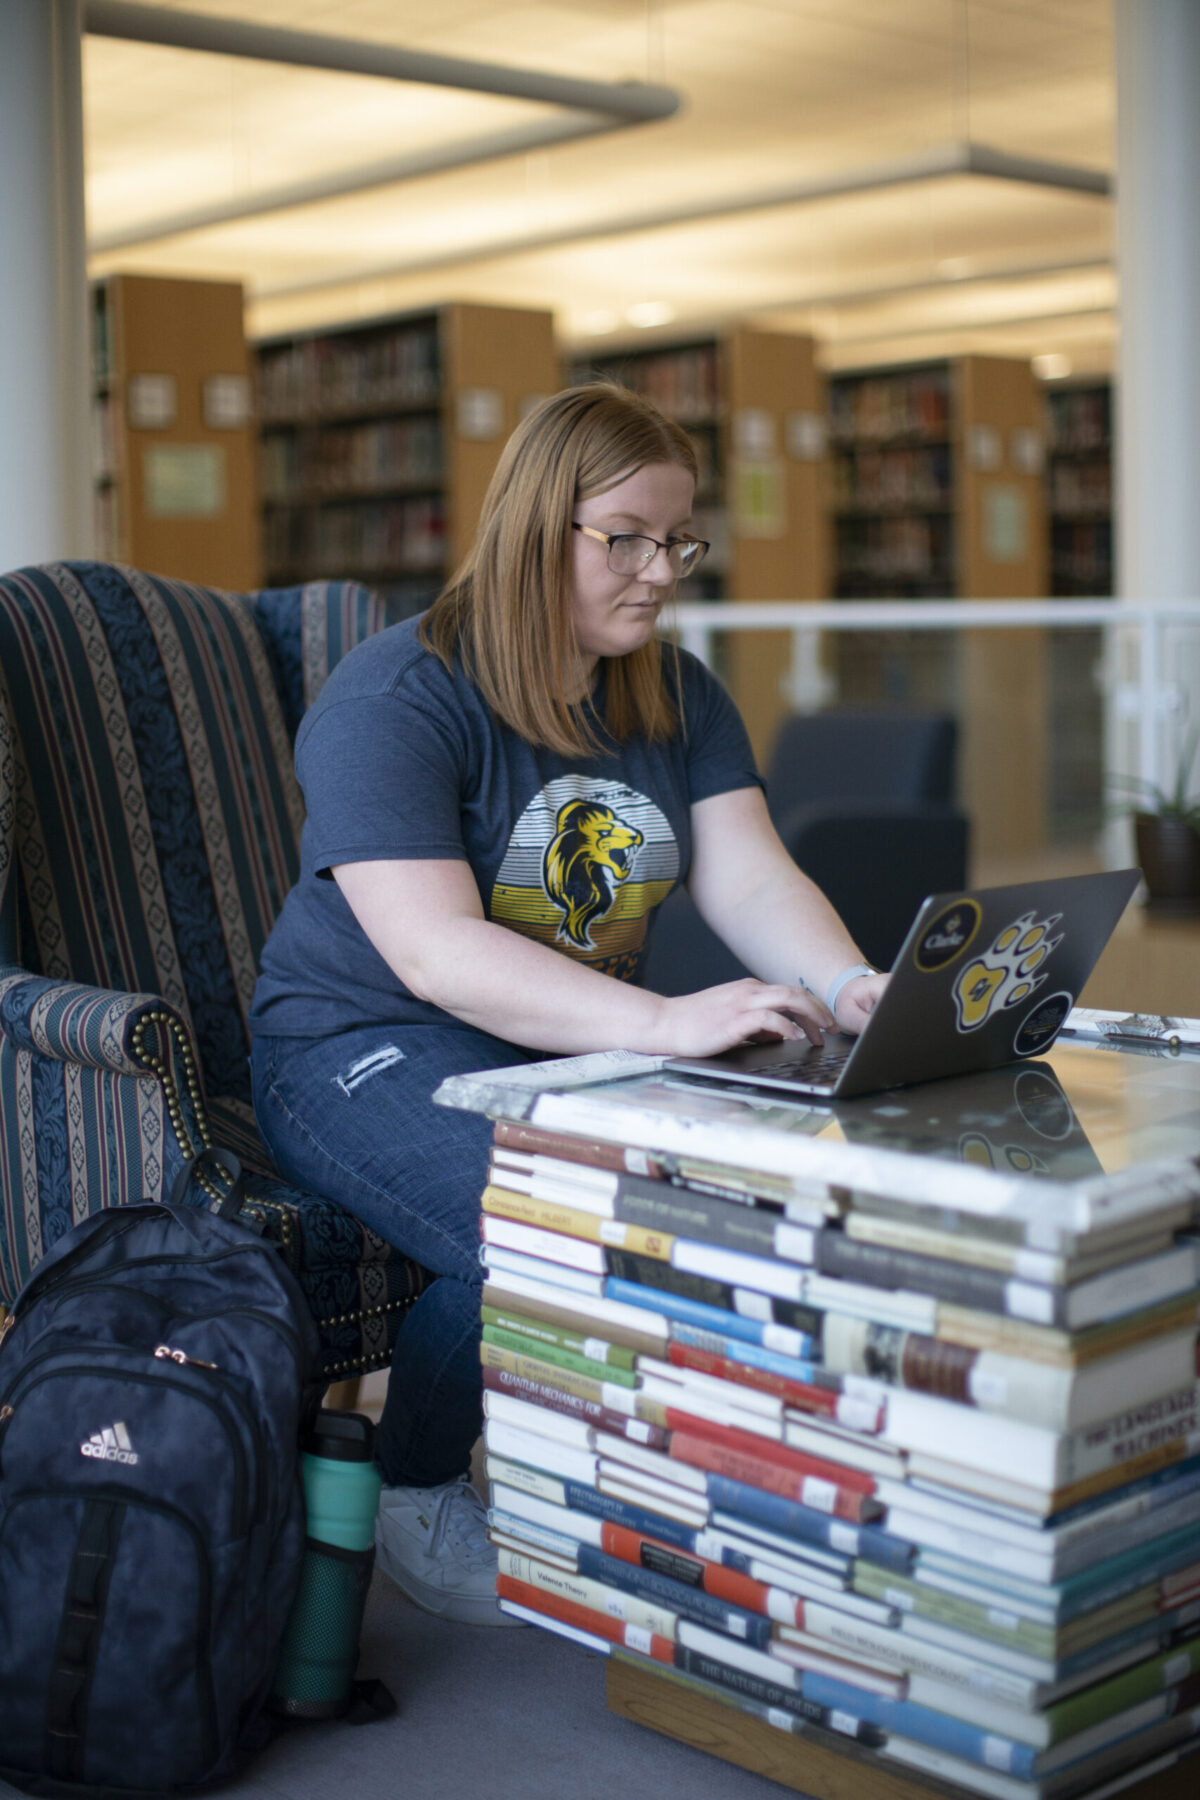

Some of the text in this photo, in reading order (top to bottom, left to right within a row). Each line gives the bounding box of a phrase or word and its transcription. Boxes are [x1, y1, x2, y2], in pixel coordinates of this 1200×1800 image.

[500, 1371, 539, 1394] QUANTUM
[540, 1386, 585, 1411] MECHANICS
[585, 1401, 602, 1416] FOR
[81, 1443, 138, 1465] adidas
[537, 1571, 588, 1600] Valence Theory
[700, 1659, 821, 1719] THE NATURE OF SOLIDS
